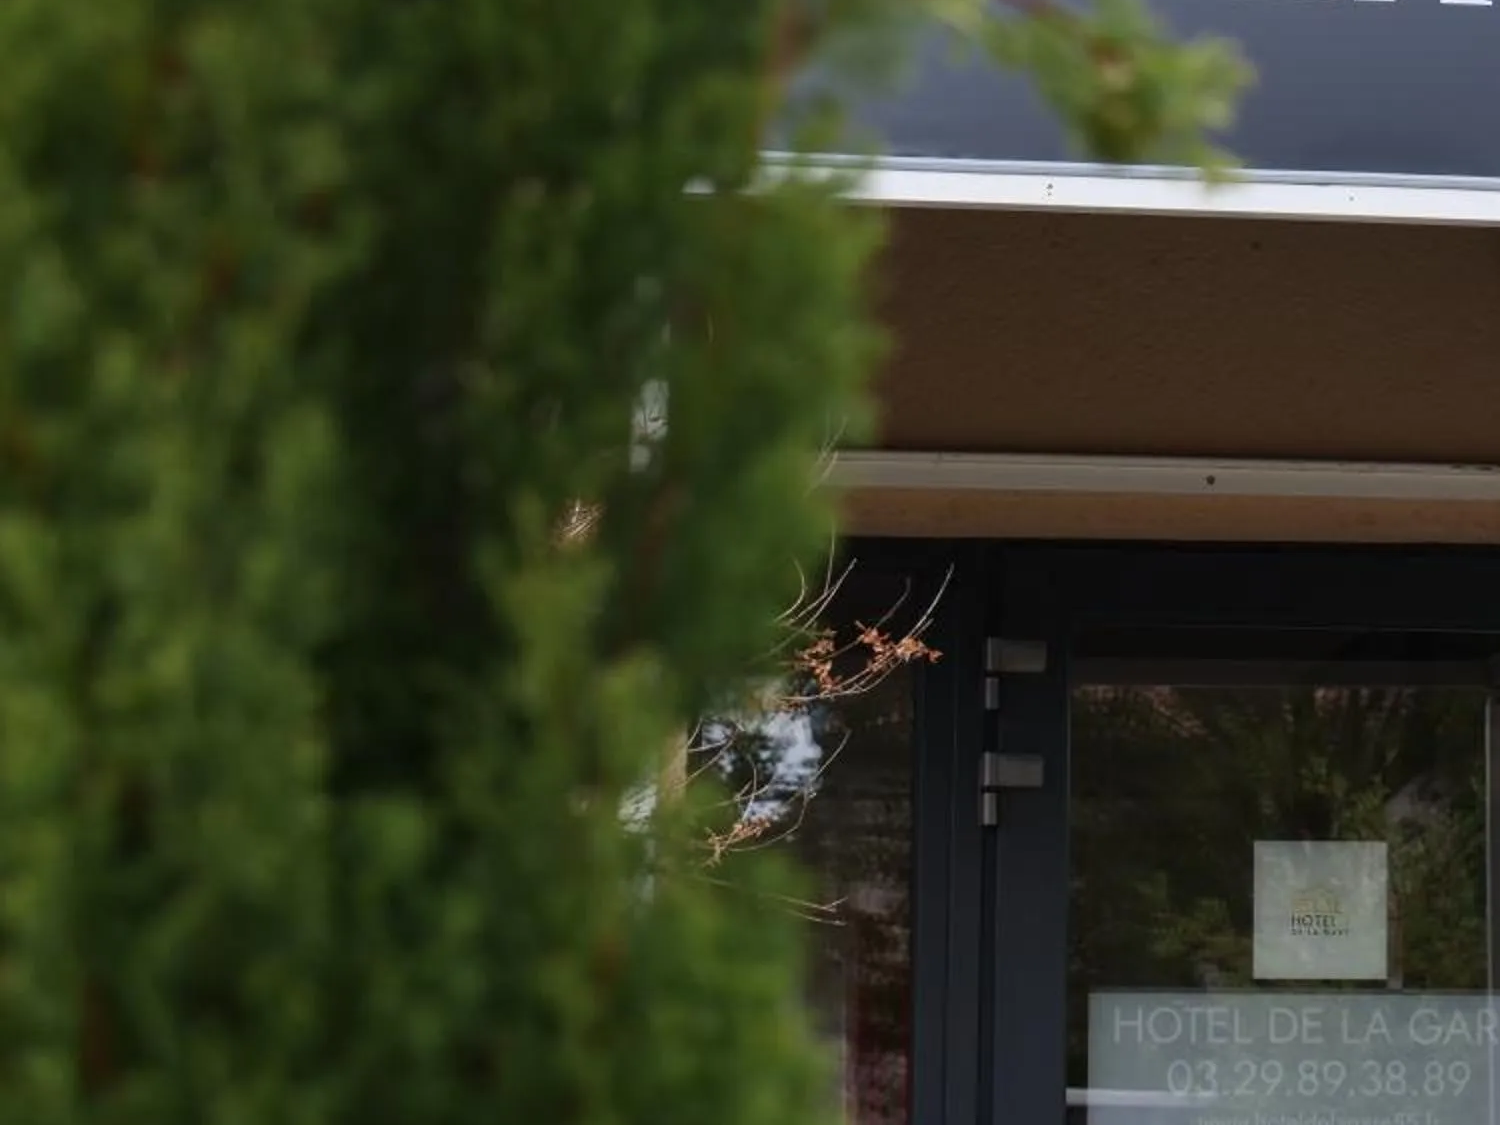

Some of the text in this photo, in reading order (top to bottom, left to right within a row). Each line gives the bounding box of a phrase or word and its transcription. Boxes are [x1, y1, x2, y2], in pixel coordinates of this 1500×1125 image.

[1291, 914, 1336, 928] HOTEL
[1112, 1005, 1253, 1045] HOTEL
[1268, 1006, 1324, 1045] DE
[1340, 1007, 1392, 1045] LA
[1166, 1058, 1472, 1098] 03.29.89.38.89
